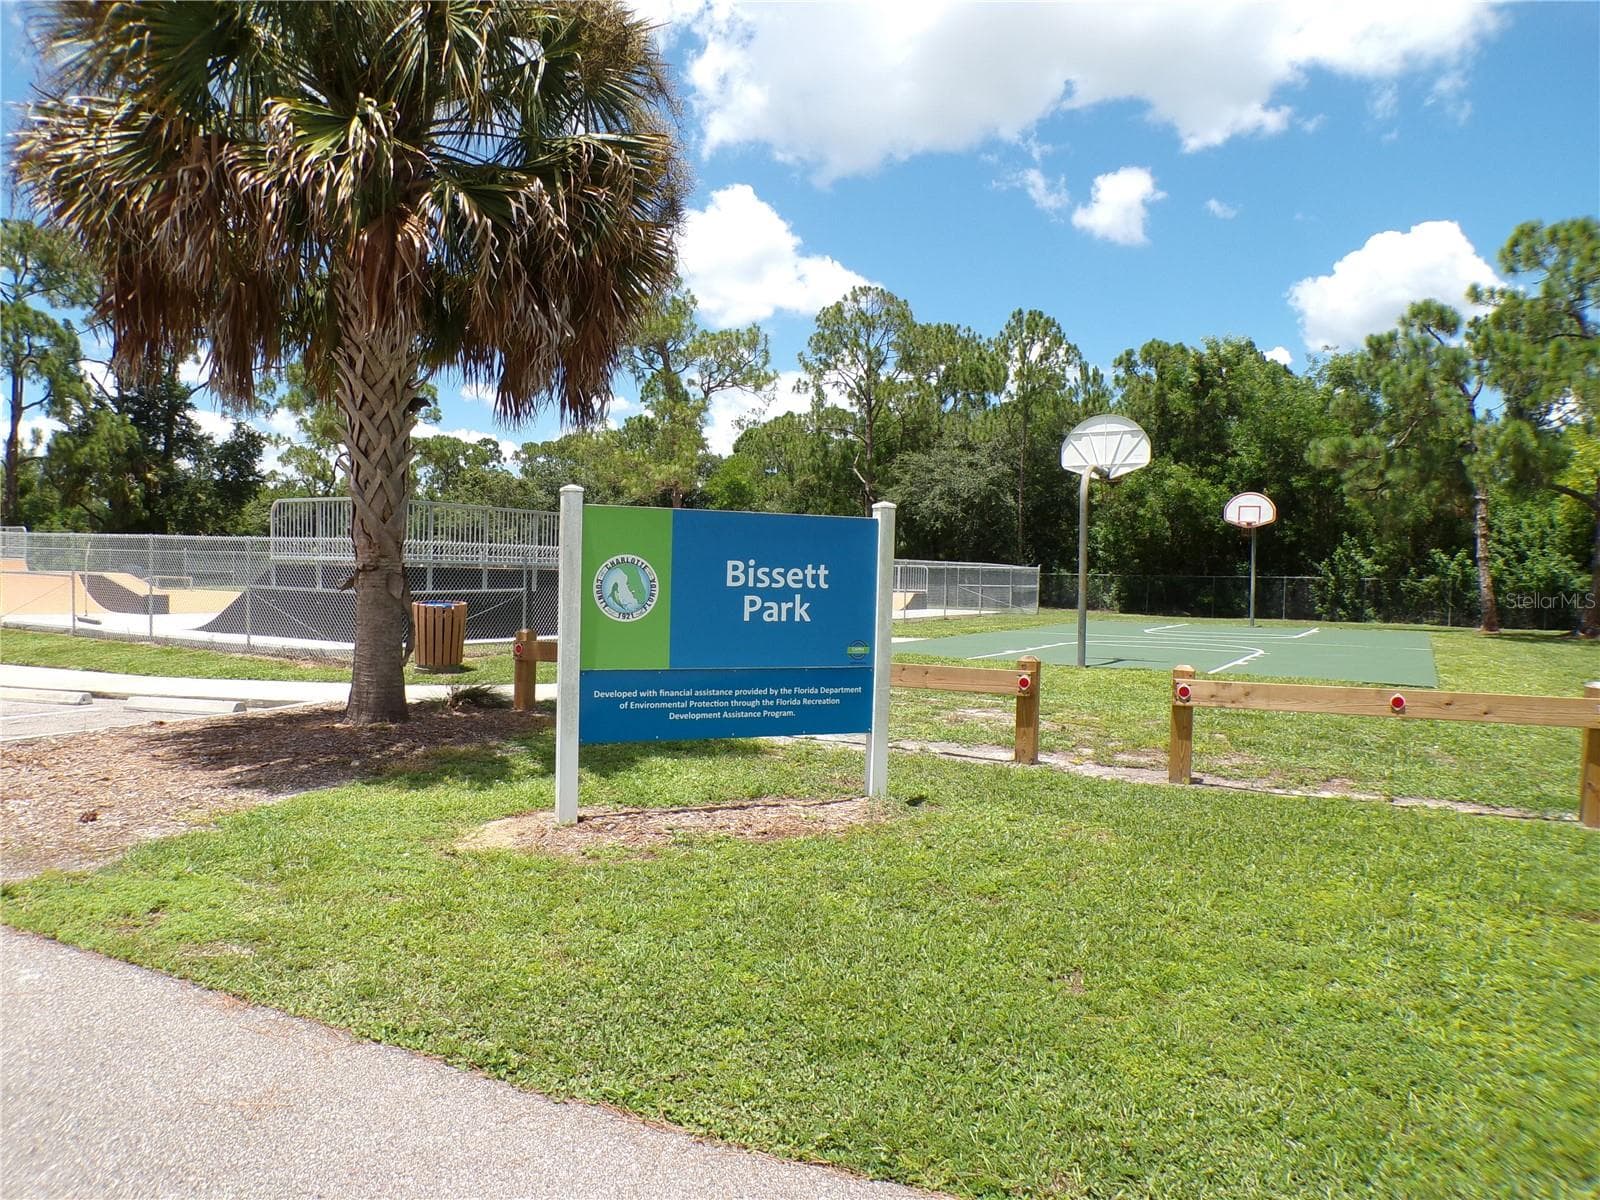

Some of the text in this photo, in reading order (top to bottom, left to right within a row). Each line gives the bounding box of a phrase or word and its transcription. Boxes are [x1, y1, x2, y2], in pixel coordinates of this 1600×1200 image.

[605, 556, 648, 570] CHARLOTTE
[726, 559, 829, 589] Bissett
[595, 578, 609, 609] COUNTY
[643, 576, 657, 611] FLORIDA
[743, 594, 811, 622] Park
[617, 612, 635, 620] 1921
[593, 686, 862, 699] Developed with financial assistance provided by the Florida Department
[619, 697, 841, 709] of Environmental Protection through the Florida Recreation
[669, 711, 721, 720] Development
[763, 710, 796, 718] Program.
